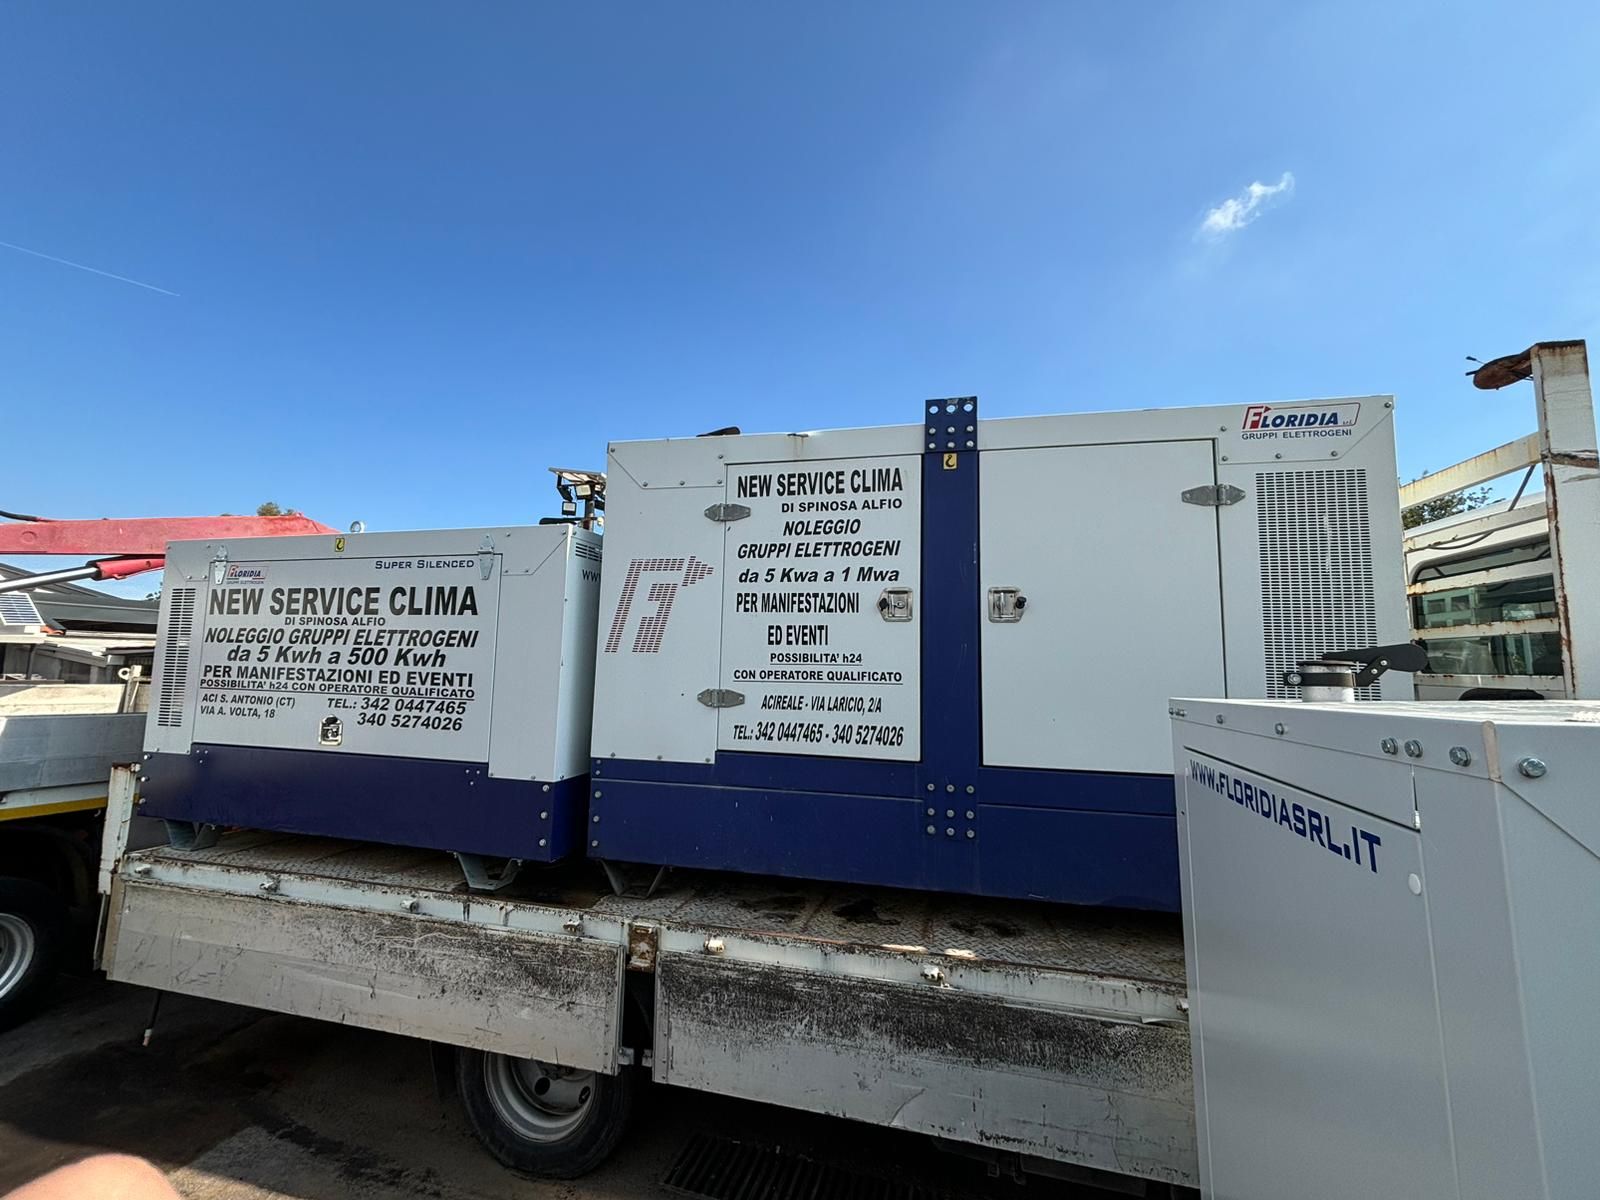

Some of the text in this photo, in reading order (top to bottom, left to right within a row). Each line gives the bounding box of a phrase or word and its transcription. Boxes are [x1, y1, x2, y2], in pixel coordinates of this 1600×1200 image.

[1243, 405, 1338, 430] FLORIDIA
[1241, 429, 1352, 440] GRUPPI ELETTROGENI
[737, 467, 903, 498] NEW SERVICE CLIMA
[781, 498, 903, 513] DI SPINOSA ALFIO
[783, 518, 861, 536] NOLEGGIO
[737, 540, 901, 559] GRUPPI ELETTROGENI
[738, 566, 899, 583] da 5 Kwa a 1 Mwa
[209, 585, 479, 617] NEW SERVICE CLIMA
[736, 592, 860, 614] PER MANIFESTAZIONI
[284, 617, 386, 626] DI SPINOSA ALFIO
[204, 627, 480, 648] NOLEGGIO GRUPPI ELETTROGENI
[767, 625, 828, 646] ED EVENTI
[227, 645, 447, 668] da 5 Kwh a 500 Kwh
[842, 653, 862, 663] h24
[203, 665, 474, 688] PER MANIFESTAZIONI ED EVENTI
[733, 669, 902, 682] CON OPERATORE QUALIFICATO
[269, 681, 289, 690] h24
[291, 682, 316, 691] CON
[318, 683, 388, 694] OPERATORE
[391, 686, 475, 699] QUALIFICATO
[202, 693, 296, 710] ACI S. ANTONIO (CT)
[327, 697, 468, 716] TEL.: 342 0447465
[761, 695, 804, 711] ACIREALE
[811, 696, 825, 711] VIA
[827, 697, 866, 715] LARICIO,
[867, 697, 882, 713] 2/A
[200, 705, 276, 719] VIA A. VOLTA, 18
[356, 712, 464, 732] 340 5274026
[733, 725, 753, 740] TEL.:
[755, 722, 779, 741] 342
[777, 722, 824, 743] 0447465
[832, 724, 851, 745] 340
[855, 725, 904, 747] 5274026
[1189, 759, 1381, 874] WWW.FLORIDIASRL.IT
